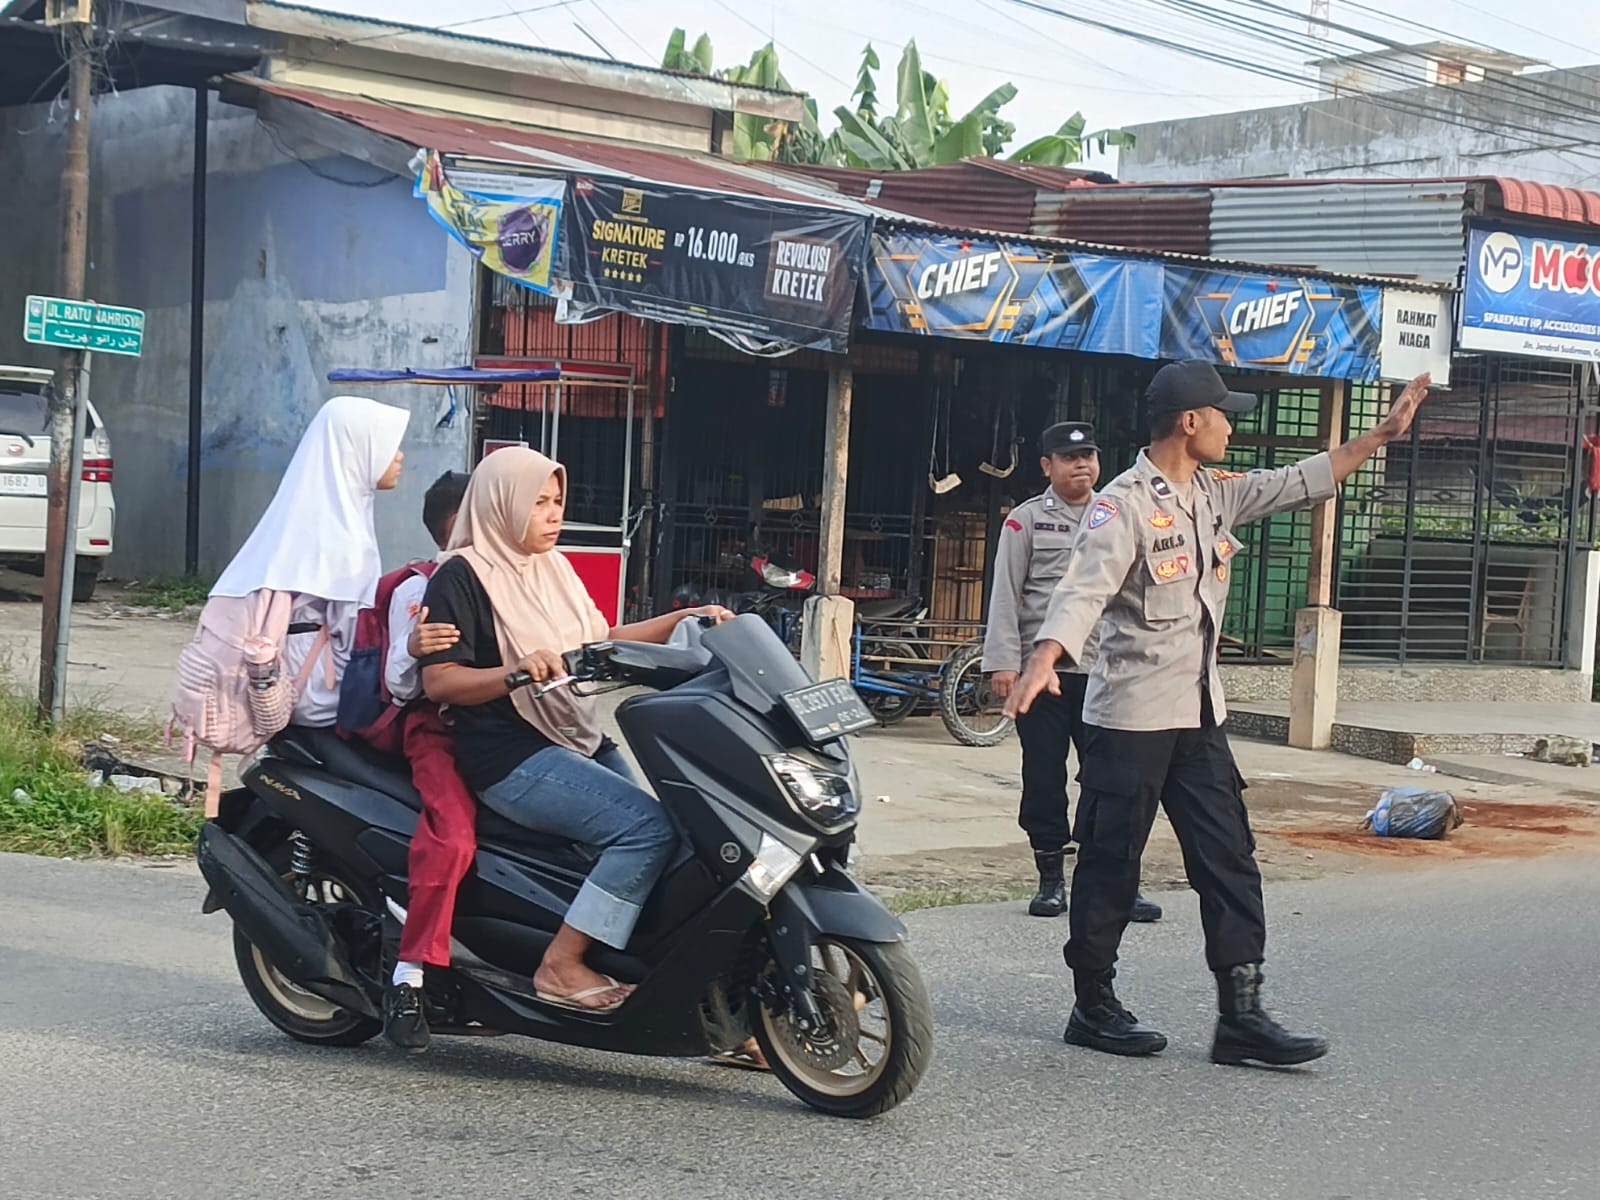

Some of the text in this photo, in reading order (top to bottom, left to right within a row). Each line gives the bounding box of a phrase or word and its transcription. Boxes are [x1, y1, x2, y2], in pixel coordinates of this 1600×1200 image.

[592, 219, 666, 250] SIGNATURE
[674, 232, 685, 248] RP
[687, 226, 739, 265] 16.000
[601, 247, 648, 270] KRETEK
[776, 240, 832, 272] REVOLUSI
[772, 268, 826, 302] KRETEK
[917, 251, 1002, 300] CHIEF
[64, 305, 92, 322] RATU
[1229, 289, 1304, 335] CHIEF
[1396, 308, 1438, 329] RAHMAT
[1398, 331, 1431, 350] NIAGA
